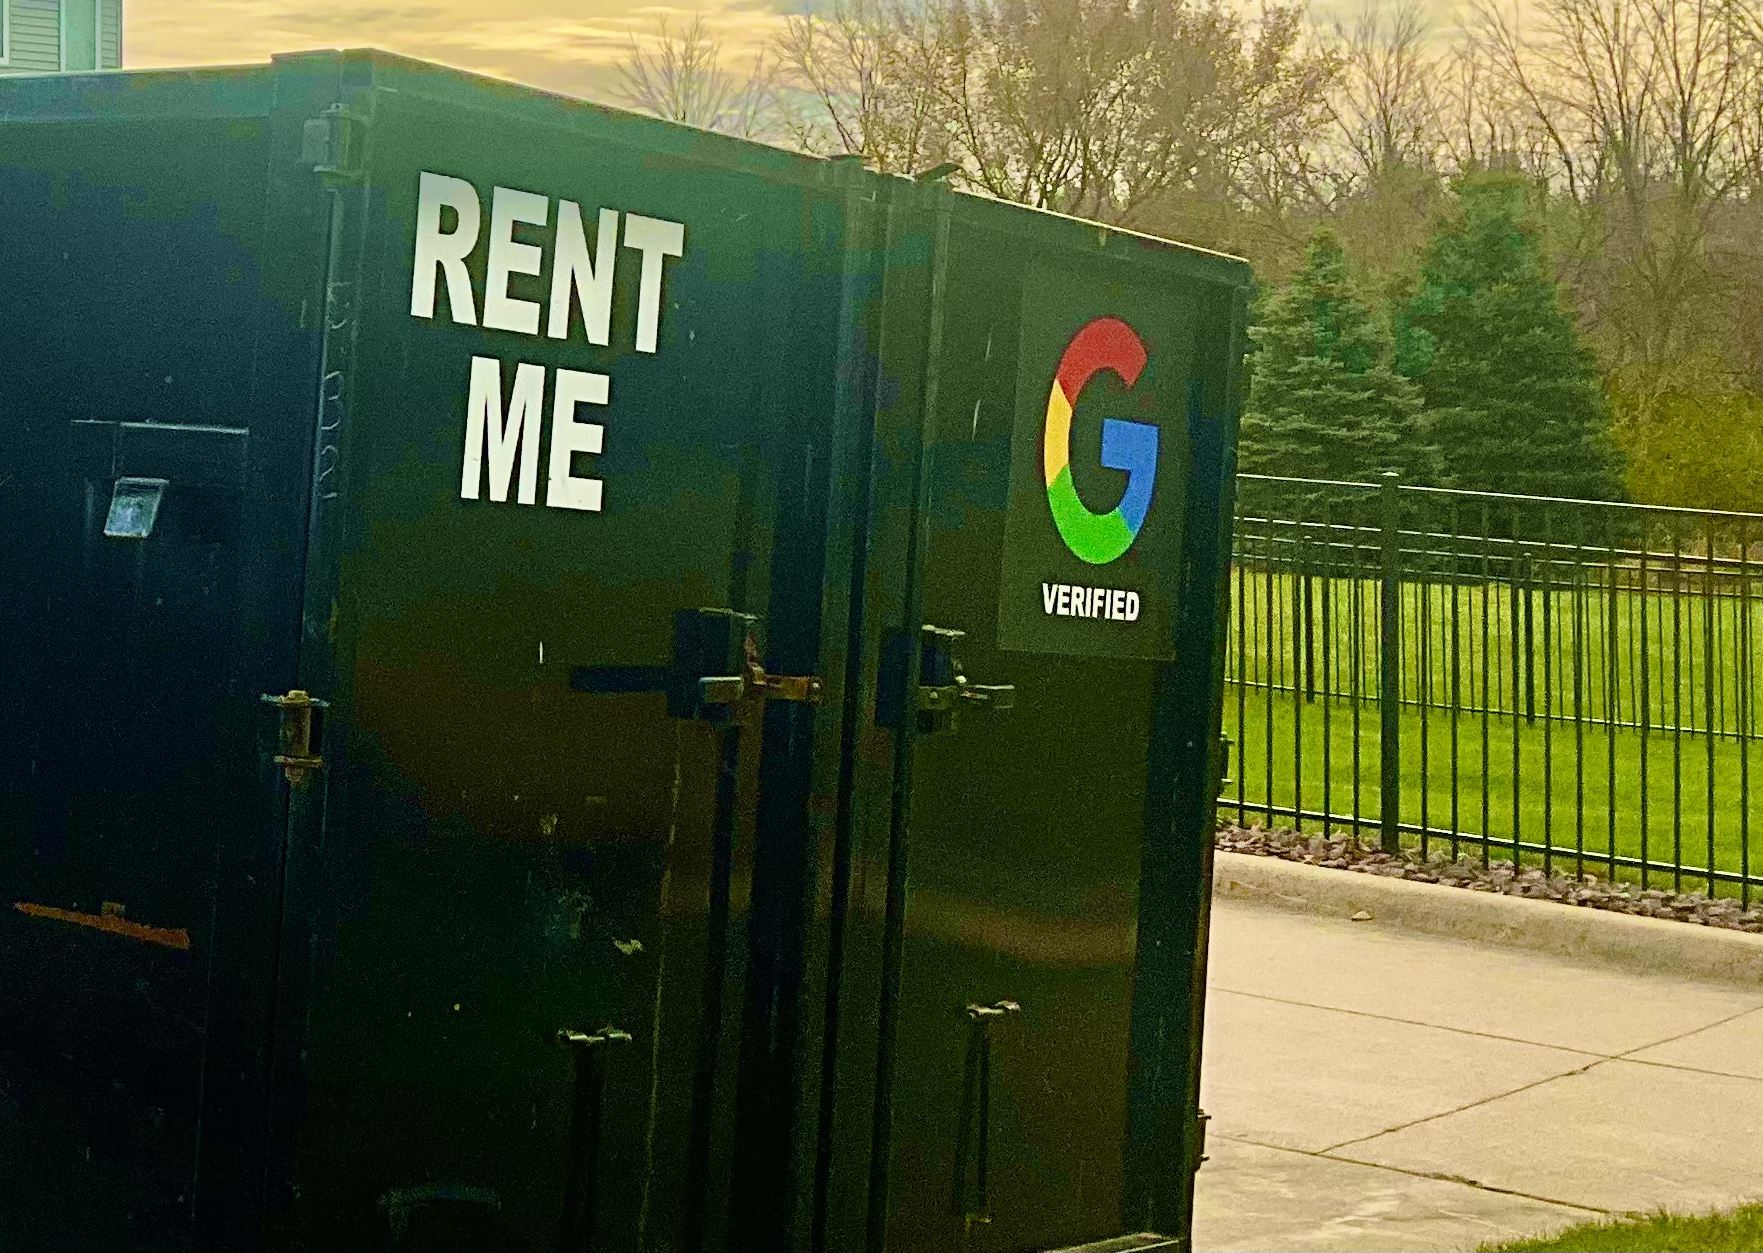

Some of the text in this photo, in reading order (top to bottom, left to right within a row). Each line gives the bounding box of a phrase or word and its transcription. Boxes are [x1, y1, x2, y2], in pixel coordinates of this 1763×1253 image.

[410, 171, 685, 354] RENT
[460, 355, 610, 512] ME
[1042, 582, 1140, 621] VERIFIED
